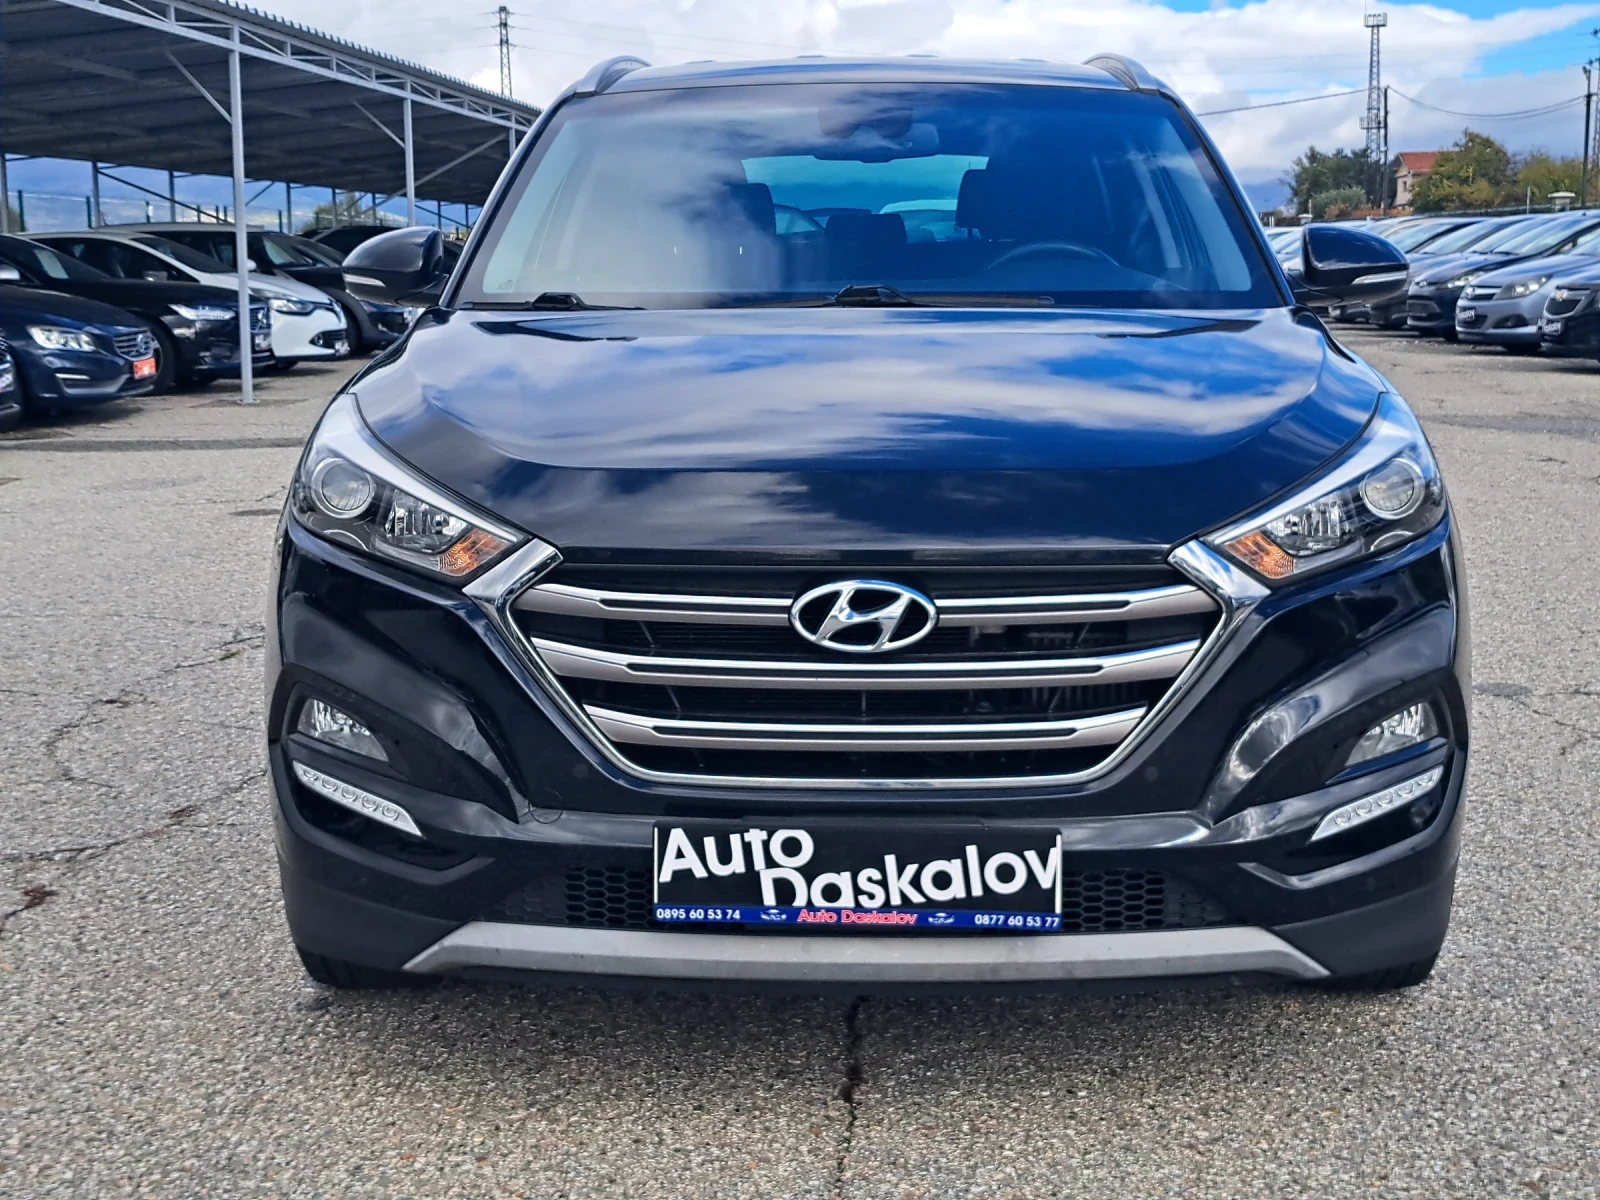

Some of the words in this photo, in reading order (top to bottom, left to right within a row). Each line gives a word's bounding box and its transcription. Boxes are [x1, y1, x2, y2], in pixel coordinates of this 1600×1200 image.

[659, 828, 815, 883] Auto
[760, 845, 1060, 909] Daskalov
[656, 908, 686, 920] 0895
[689, 908, 704, 920] 60
[707, 909, 722, 920] 53
[726, 909, 741, 920] 74
[797, 908, 837, 923] Auto
[841, 909, 918, 924] Daskalov
[974, 913, 1004, 926] 0877
[1007, 915, 1023, 927] 60
[1026, 916, 1041, 928] 53
[1044, 916, 1060, 928] 77
